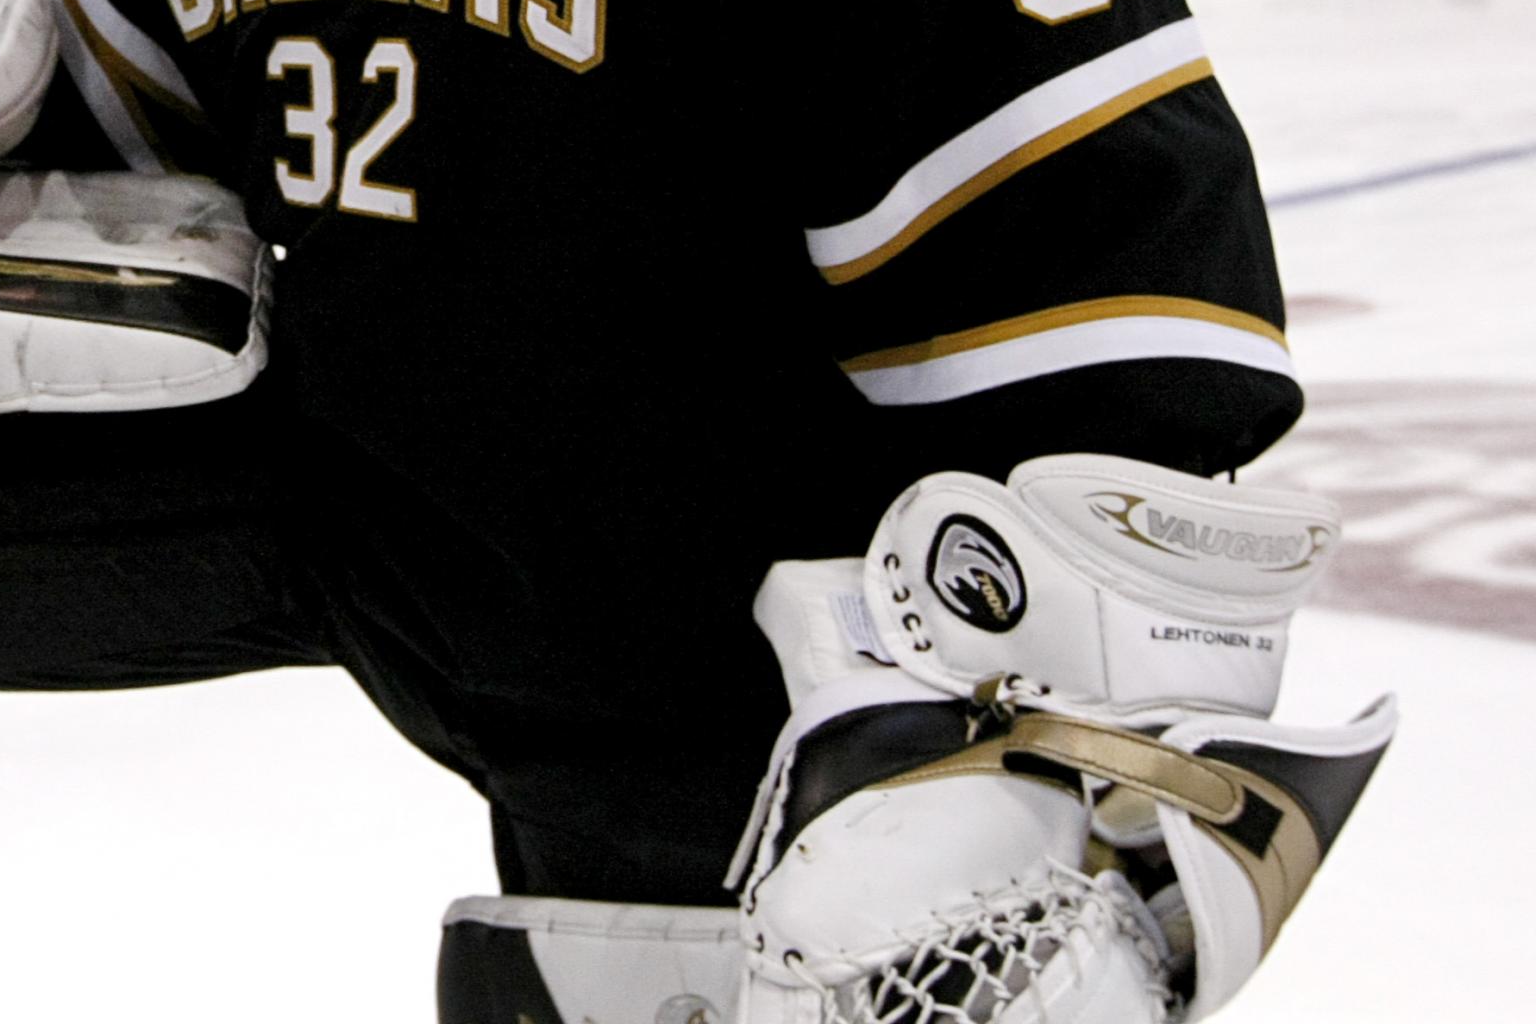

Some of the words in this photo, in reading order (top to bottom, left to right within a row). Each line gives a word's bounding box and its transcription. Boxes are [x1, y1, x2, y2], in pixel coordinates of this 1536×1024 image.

[266, 35, 418, 222] 32
[1146, 507, 1306, 563] VAUGHN
[1150, 626, 1251, 649] LEHTONEN
